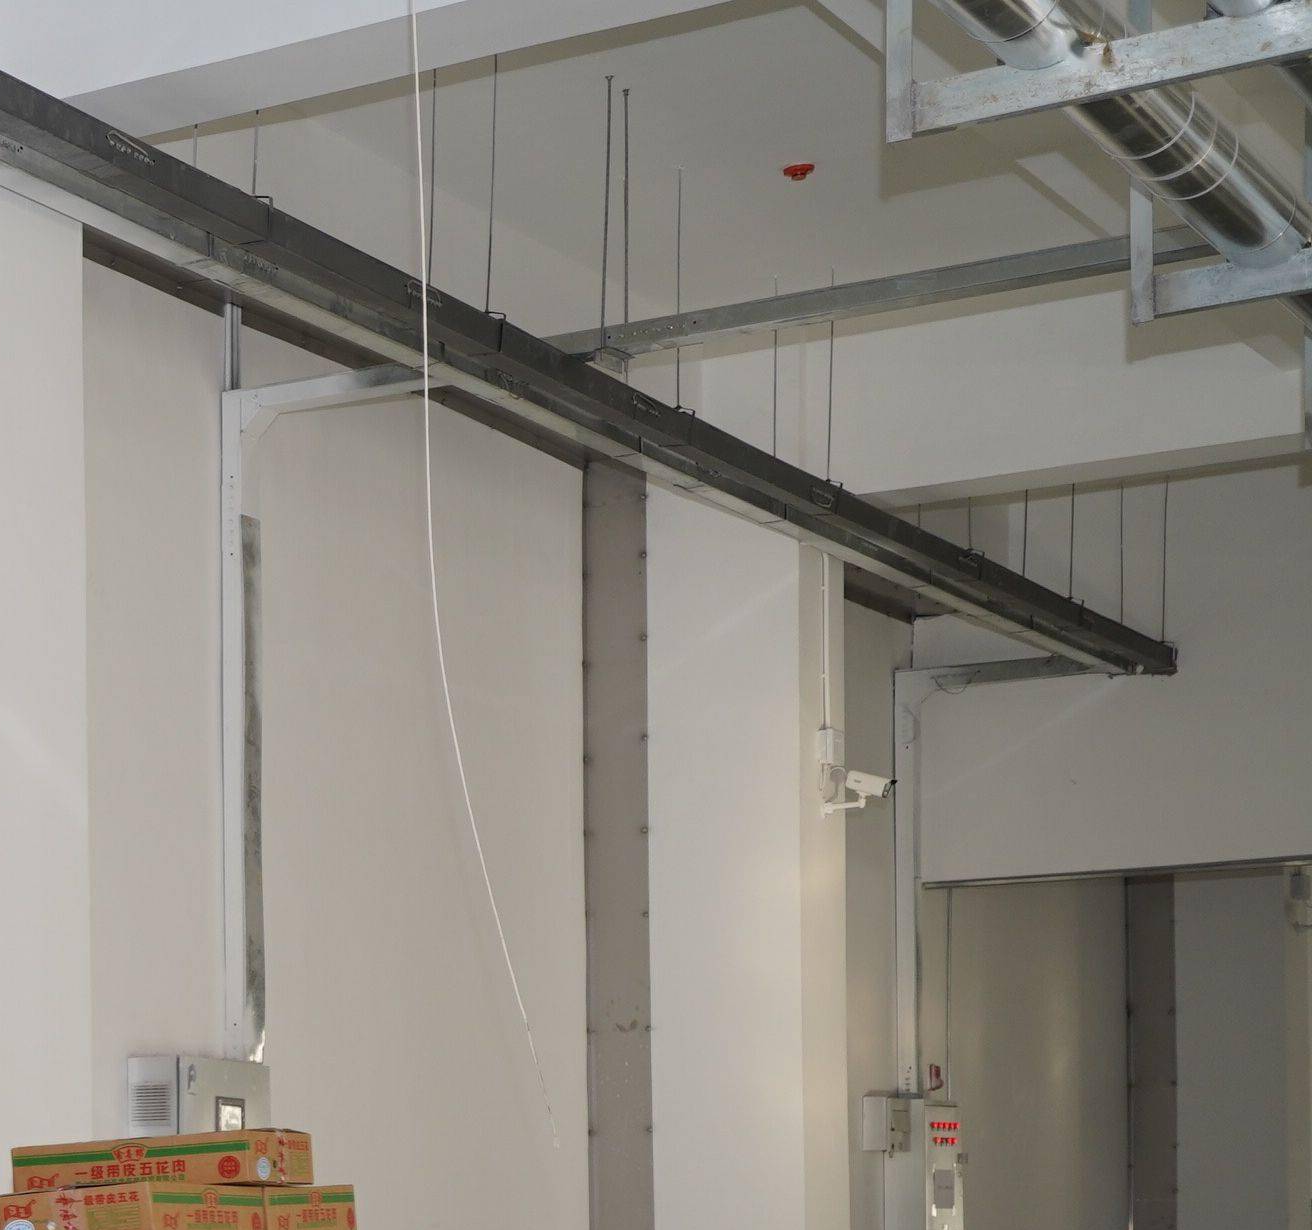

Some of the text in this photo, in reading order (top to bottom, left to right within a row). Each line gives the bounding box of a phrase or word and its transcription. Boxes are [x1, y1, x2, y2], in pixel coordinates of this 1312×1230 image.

[76, 1159, 186, 1179] 一级带皮五花肉
